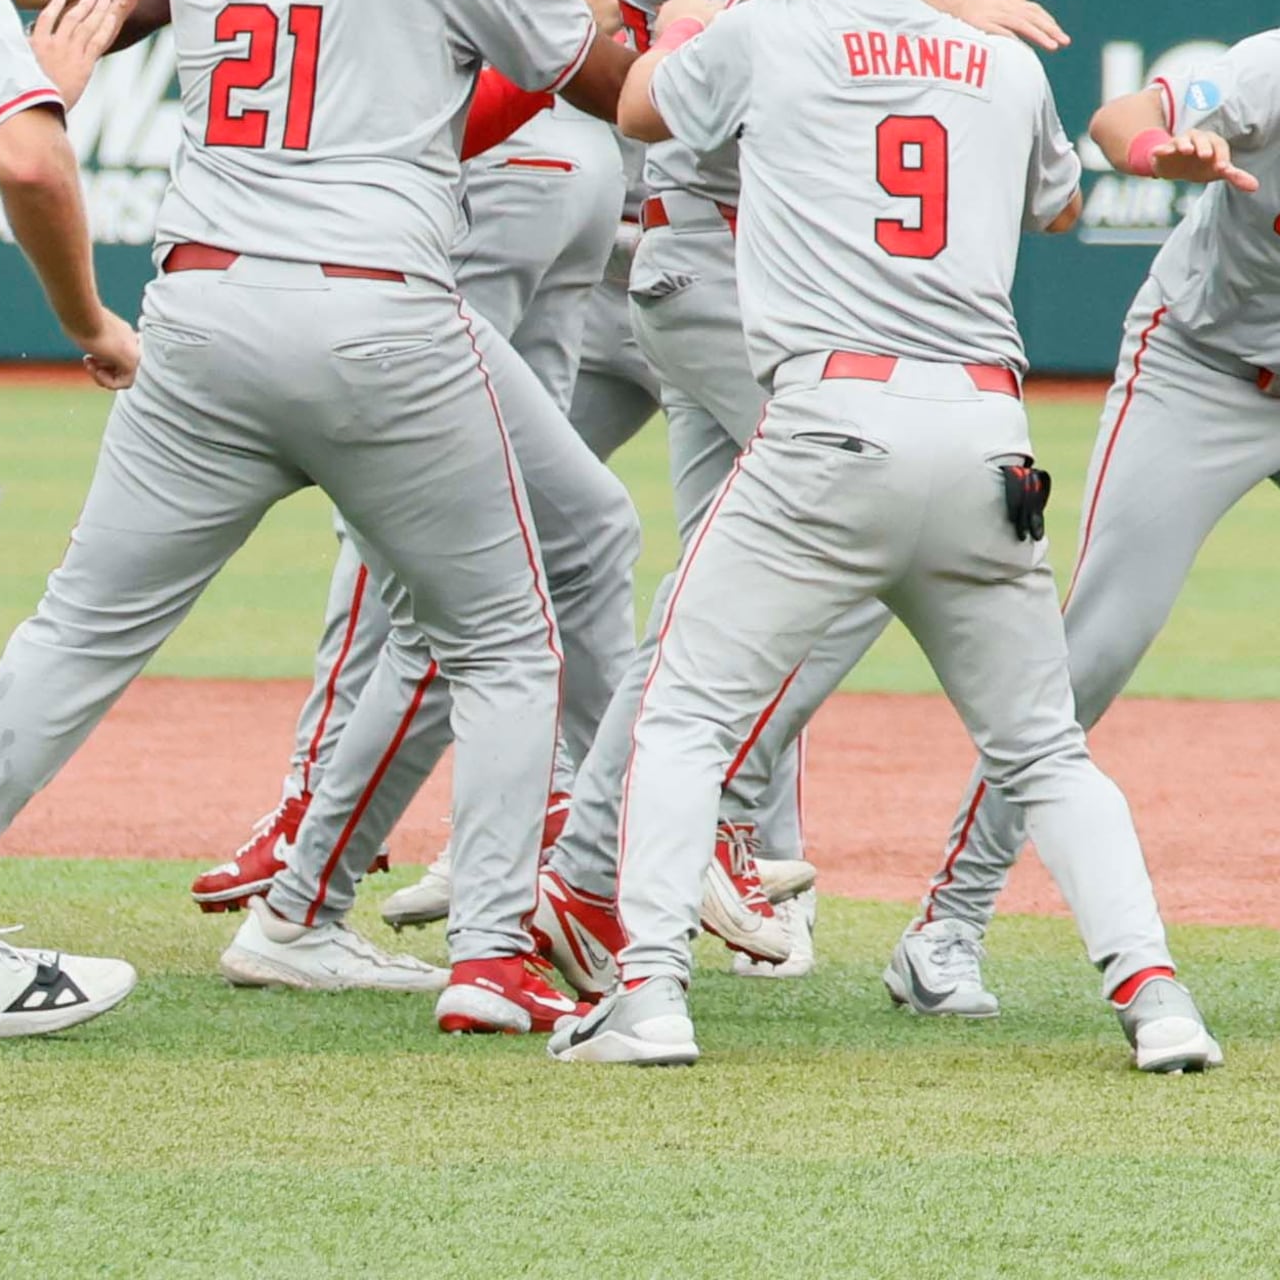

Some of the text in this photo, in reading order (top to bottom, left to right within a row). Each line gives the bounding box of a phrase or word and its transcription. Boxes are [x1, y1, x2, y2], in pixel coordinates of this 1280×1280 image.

[204, 2, 324, 151] 21
[842, 30, 988, 89] BRANCH
[874, 114, 948, 260] 9
